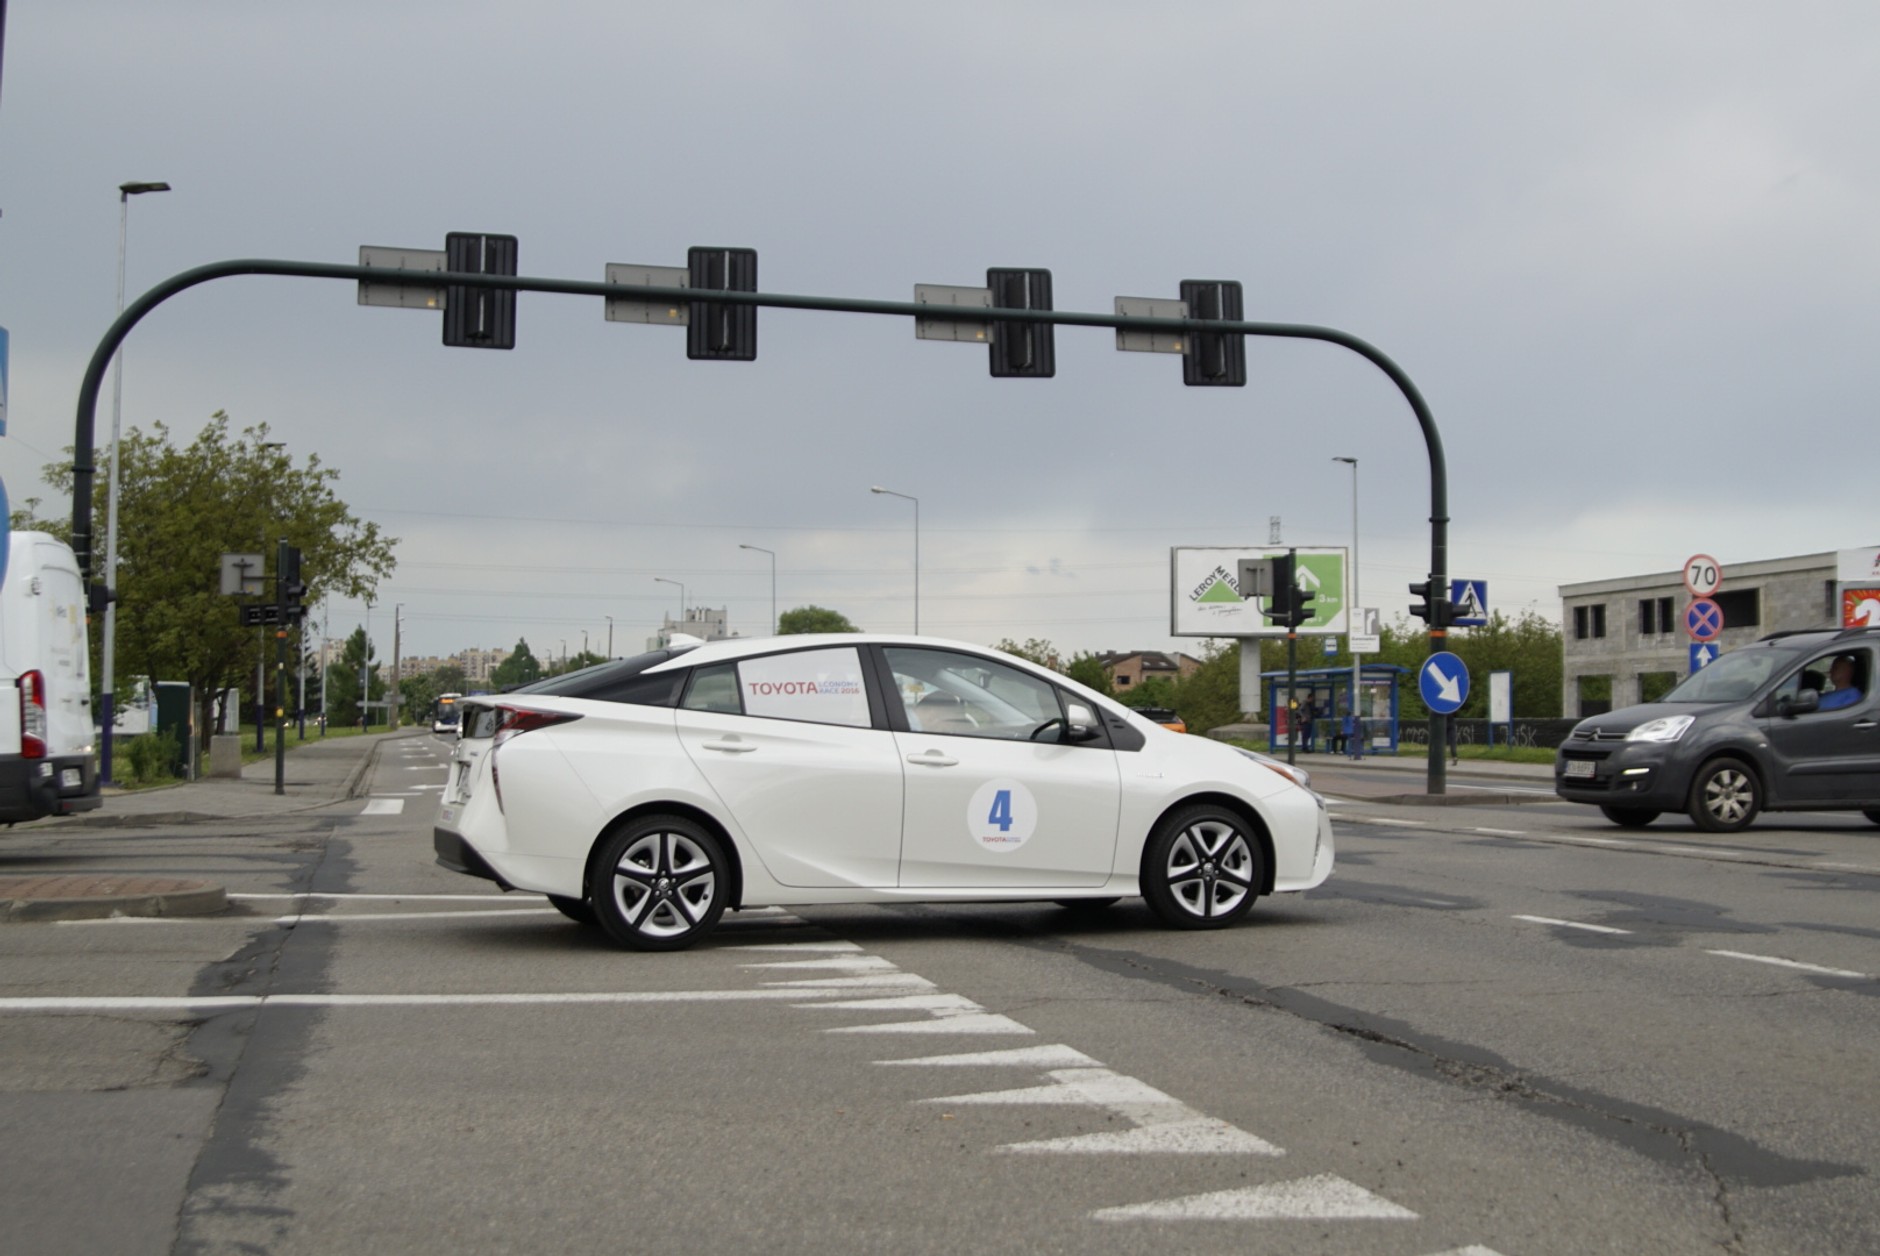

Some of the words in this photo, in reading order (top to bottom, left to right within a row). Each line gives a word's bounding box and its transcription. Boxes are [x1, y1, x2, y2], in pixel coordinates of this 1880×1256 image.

[1189, 572, 1217, 601] LEROY
[1215, 565, 1241, 592] MERL
[1692, 565, 1717, 586] 70
[1319, 594, 1326, 603] 3
[749, 681, 818, 695] TOYOTA
[988, 789, 1013, 832] 4
